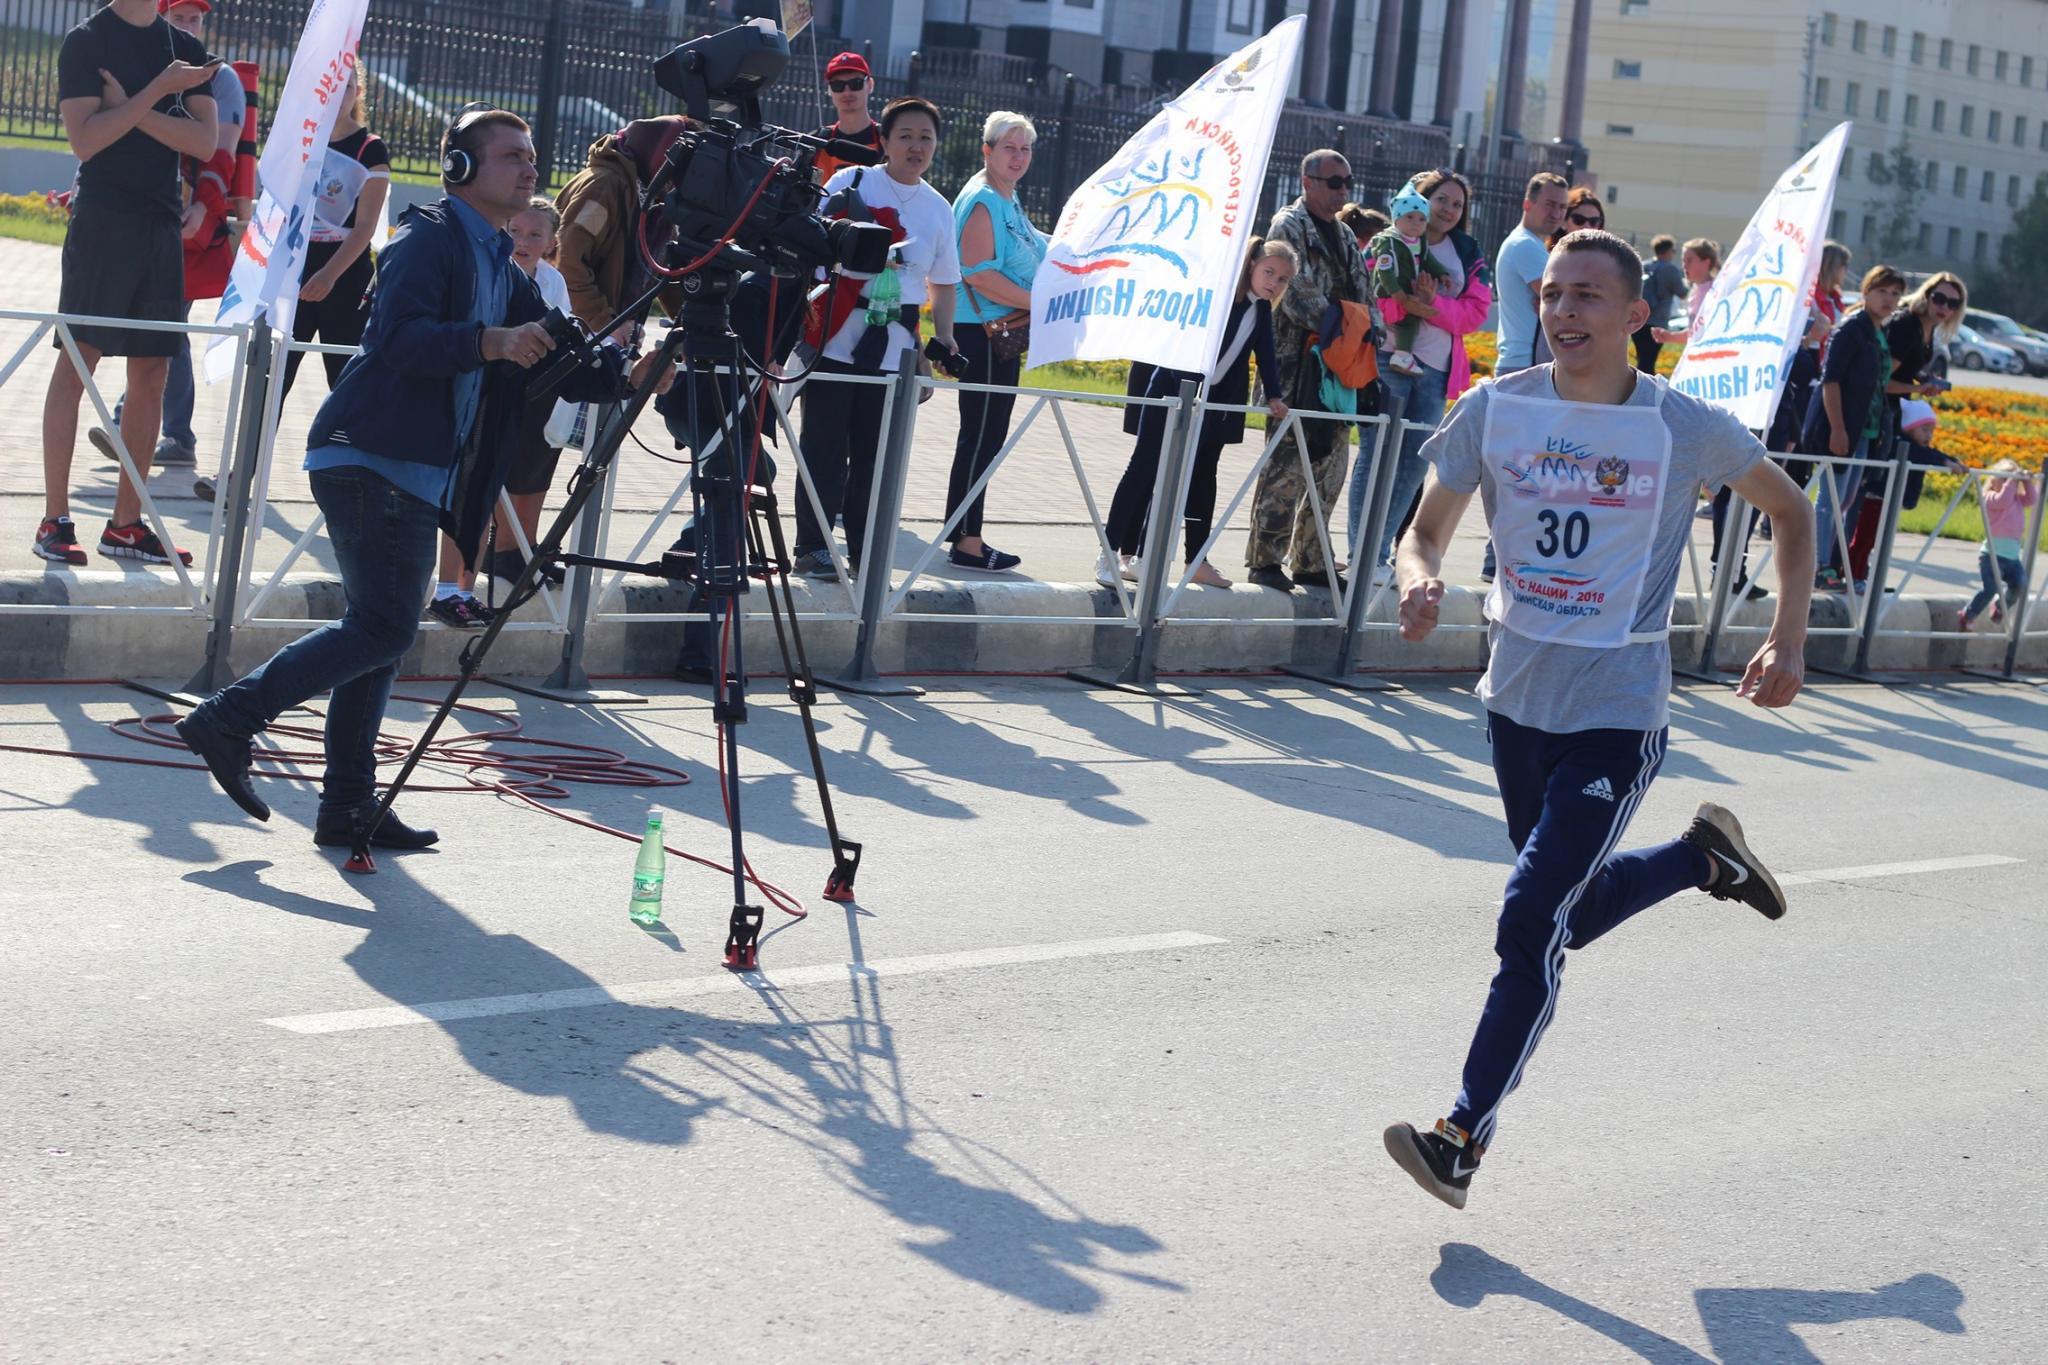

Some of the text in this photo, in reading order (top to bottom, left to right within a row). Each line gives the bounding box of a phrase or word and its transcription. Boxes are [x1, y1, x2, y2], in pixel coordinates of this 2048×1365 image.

[1536, 509, 1590, 559] 30
[1528, 581, 1568, 600] НАЦИИ
[1576, 591, 1605, 603] 2018
[1582, 787, 1614, 802] adidas
